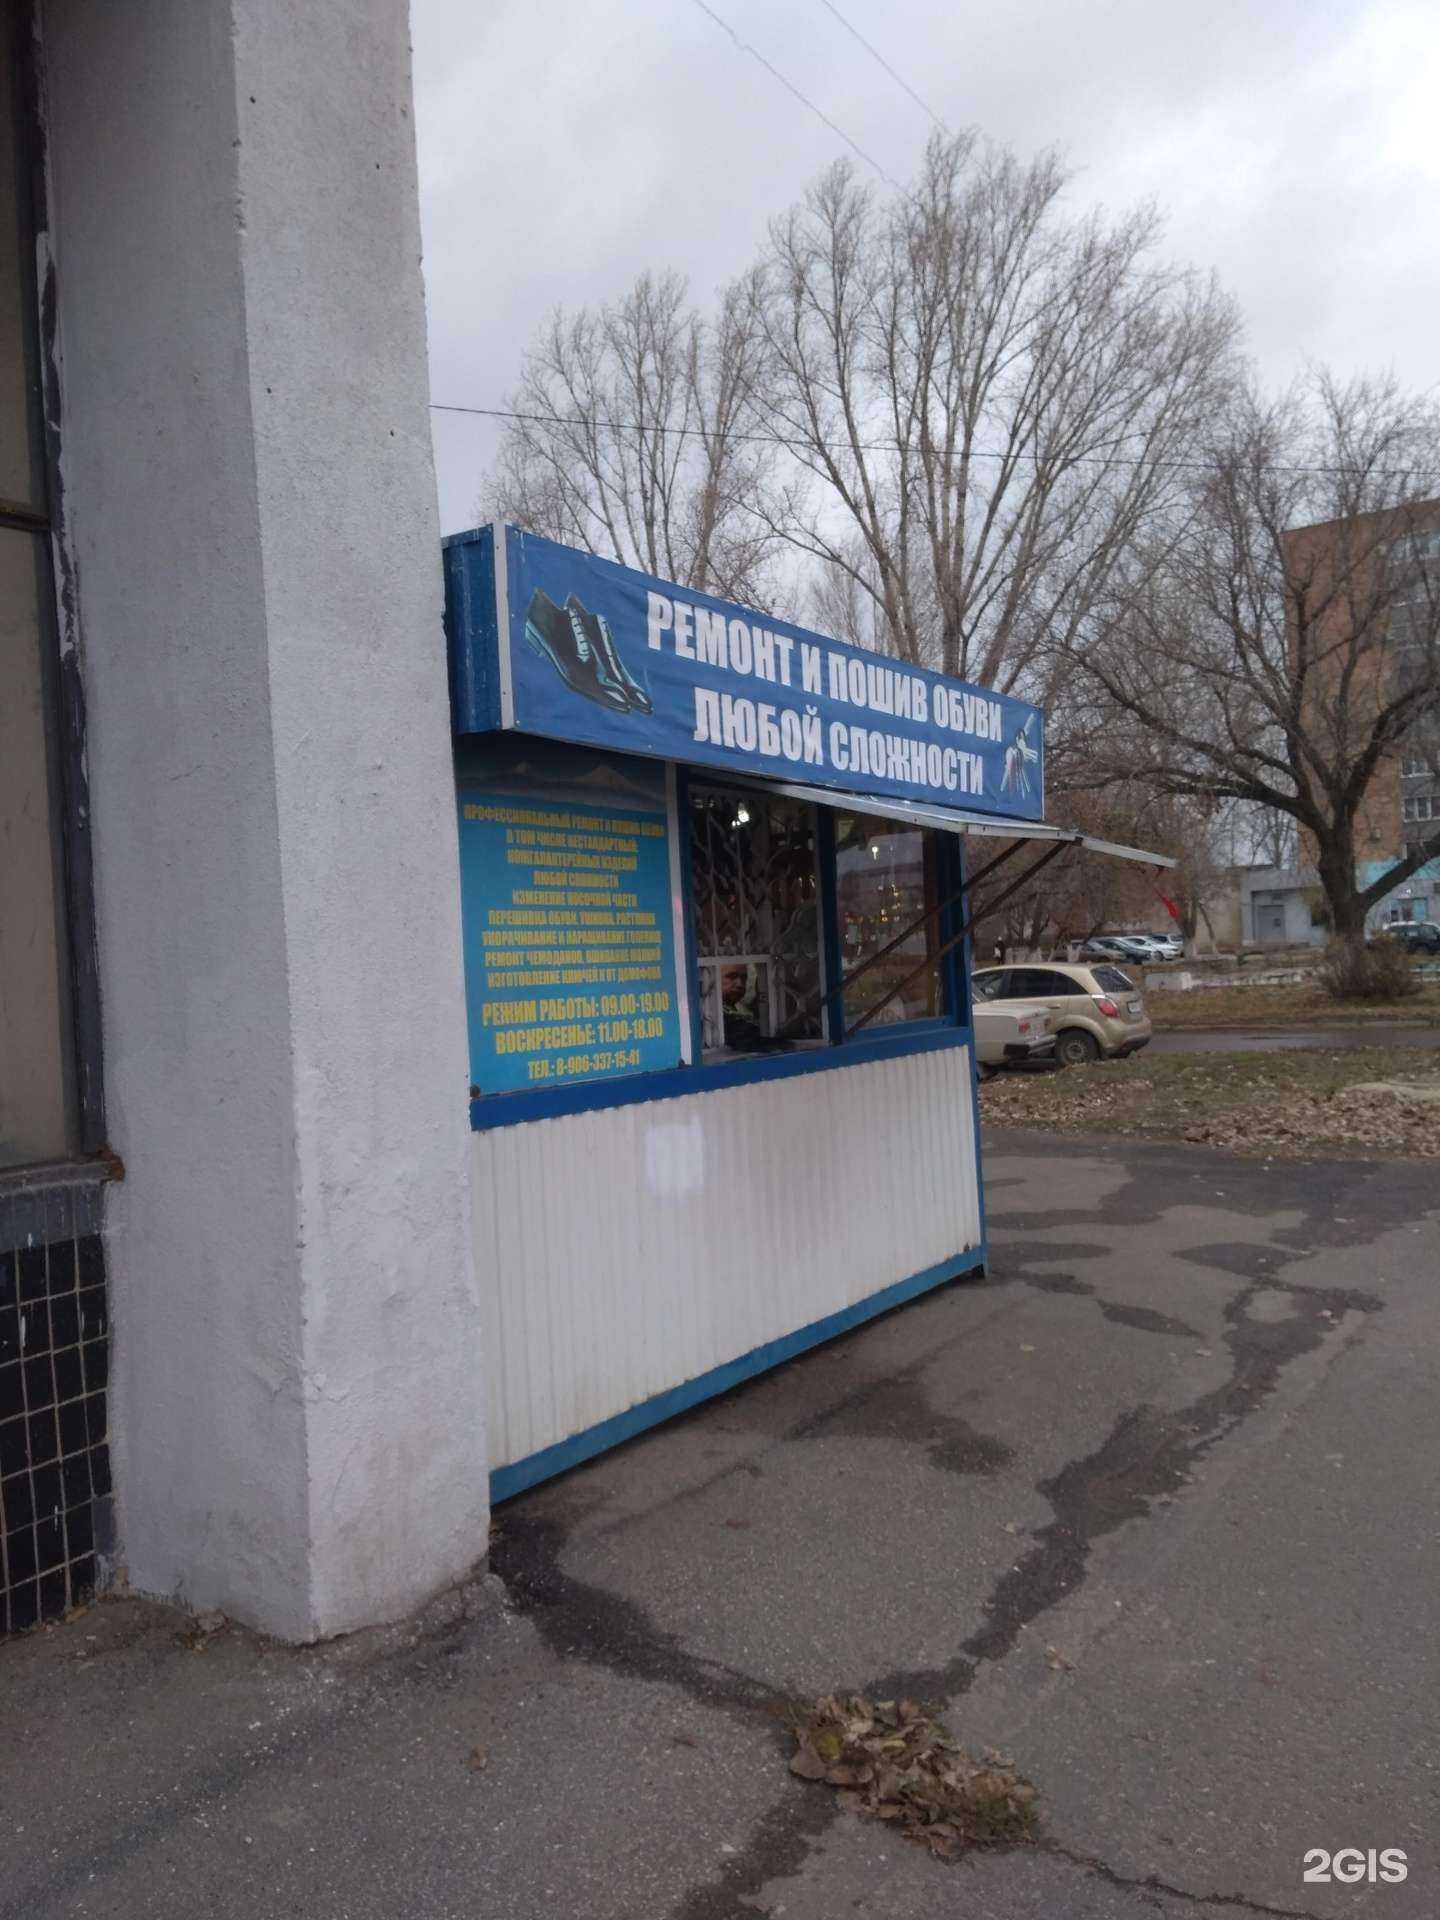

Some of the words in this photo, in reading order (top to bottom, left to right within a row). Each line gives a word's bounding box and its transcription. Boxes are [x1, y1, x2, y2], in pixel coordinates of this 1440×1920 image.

[647, 590, 794, 687] РЕМОНТ
[801, 641, 822, 695] И
[828, 651, 928, 723] ПОШИВ
[933, 682, 1003, 743] ОБУВИ
[693, 686, 824, 766] ЛЮБОЙ
[829, 720, 984, 796] СЛОЖНОСТИ
[482, 1000, 537, 1027] РЕЖИМ
[539, 996, 599, 1022] РАБОТЫ:
[600, 991, 669, 1017] 09.00-19.00
[495, 1023, 596, 1055] ВОСКРЕСЕНЬЕ:
[597, 1016, 663, 1043] 11.00-18.00
[527, 1059, 555, 1080] ТЕЛ.:
